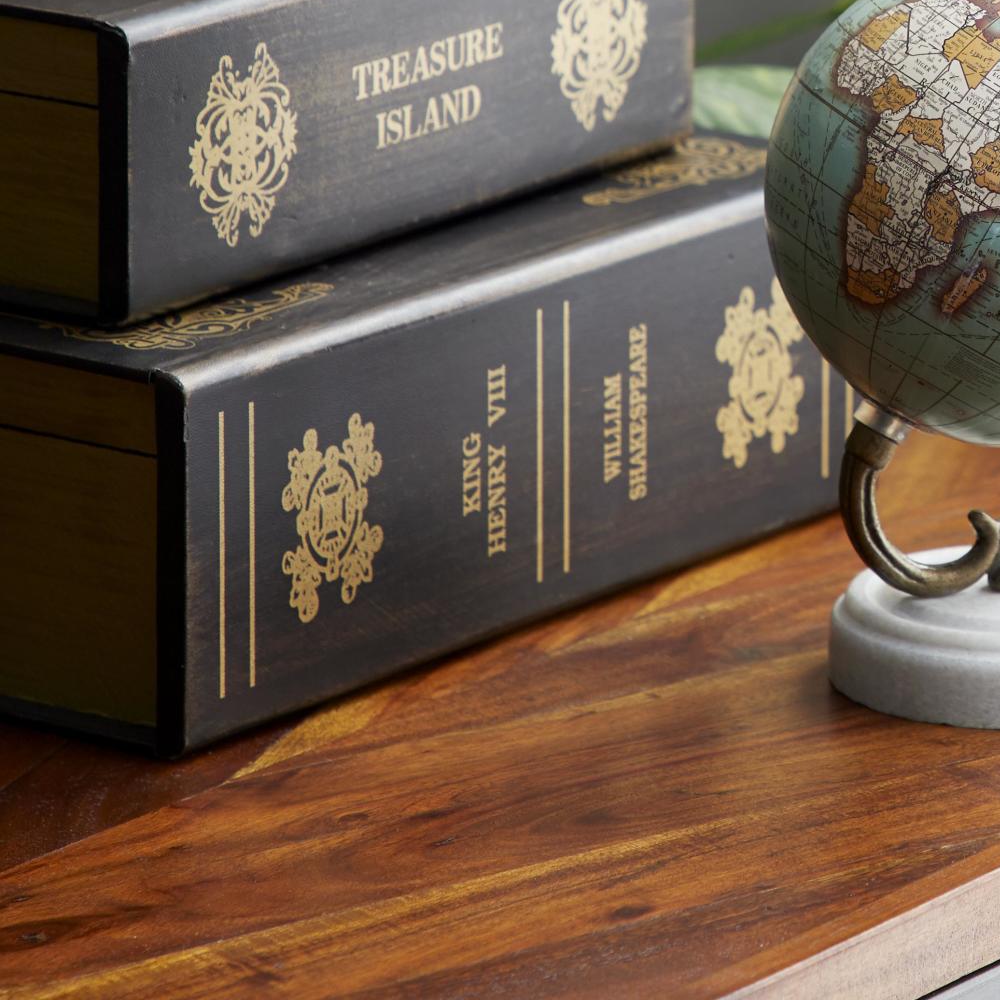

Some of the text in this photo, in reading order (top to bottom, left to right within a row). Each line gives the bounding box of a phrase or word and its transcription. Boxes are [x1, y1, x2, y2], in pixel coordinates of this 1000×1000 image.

[352, 21, 504, 101] TREASURE
[940, 78, 959, 92] CHAD
[375, 84, 482, 150] ISLAND
[603, 372, 622, 484] WILLIAM
[628, 322, 648, 501] SHAKESPEARE
[462, 432, 482, 517] KING
[487, 363, 507, 557] HENRY VIII
